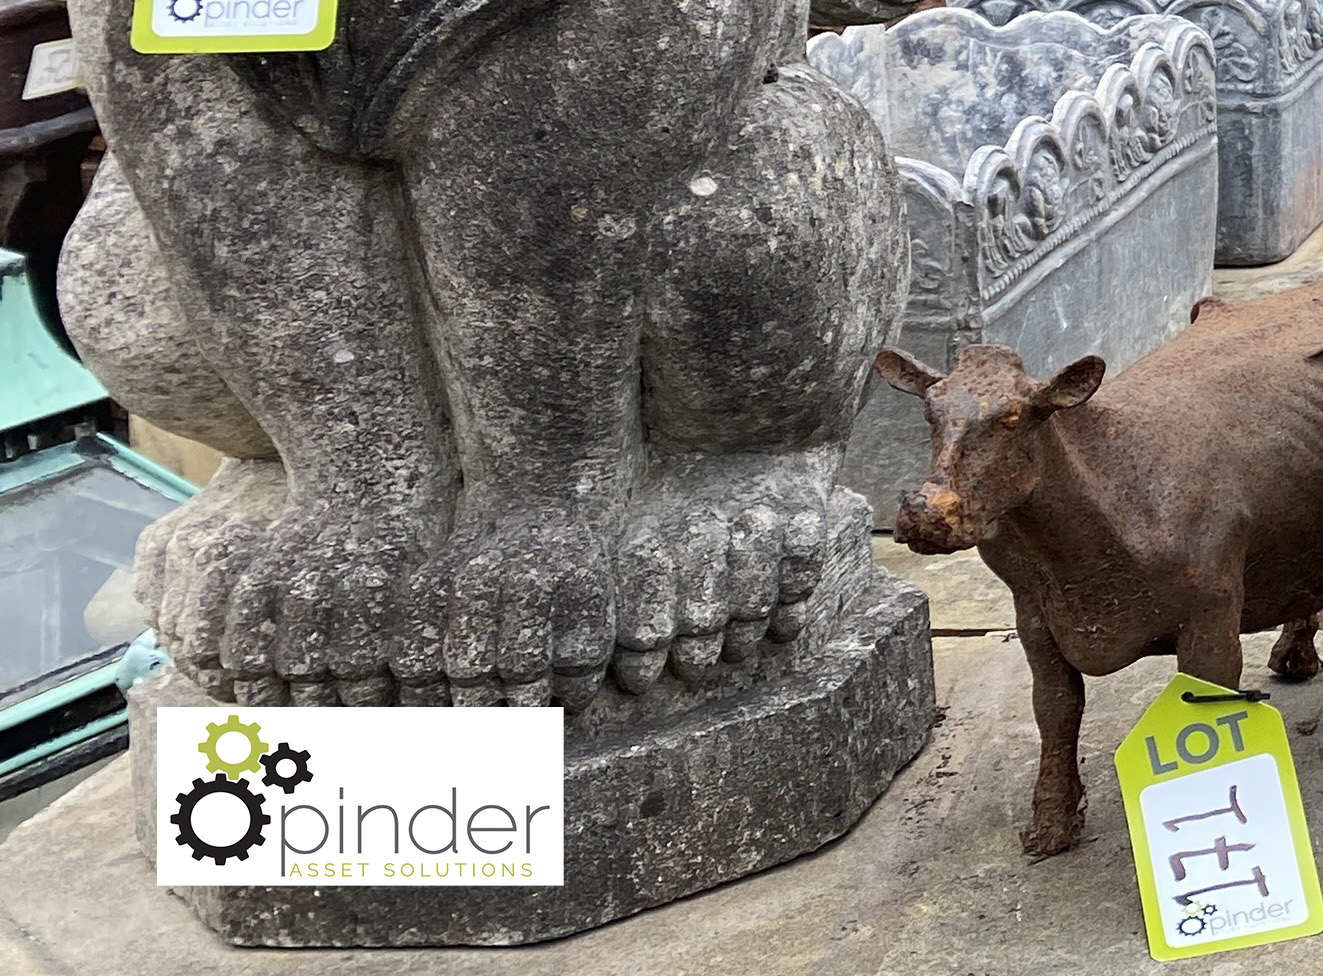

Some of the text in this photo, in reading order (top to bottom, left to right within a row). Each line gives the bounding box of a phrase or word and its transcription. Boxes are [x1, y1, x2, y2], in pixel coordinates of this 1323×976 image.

[1145, 710, 1249, 776] LOT
[1162, 784, 1270, 906] 171
[1208, 897, 1294, 936] pinder
